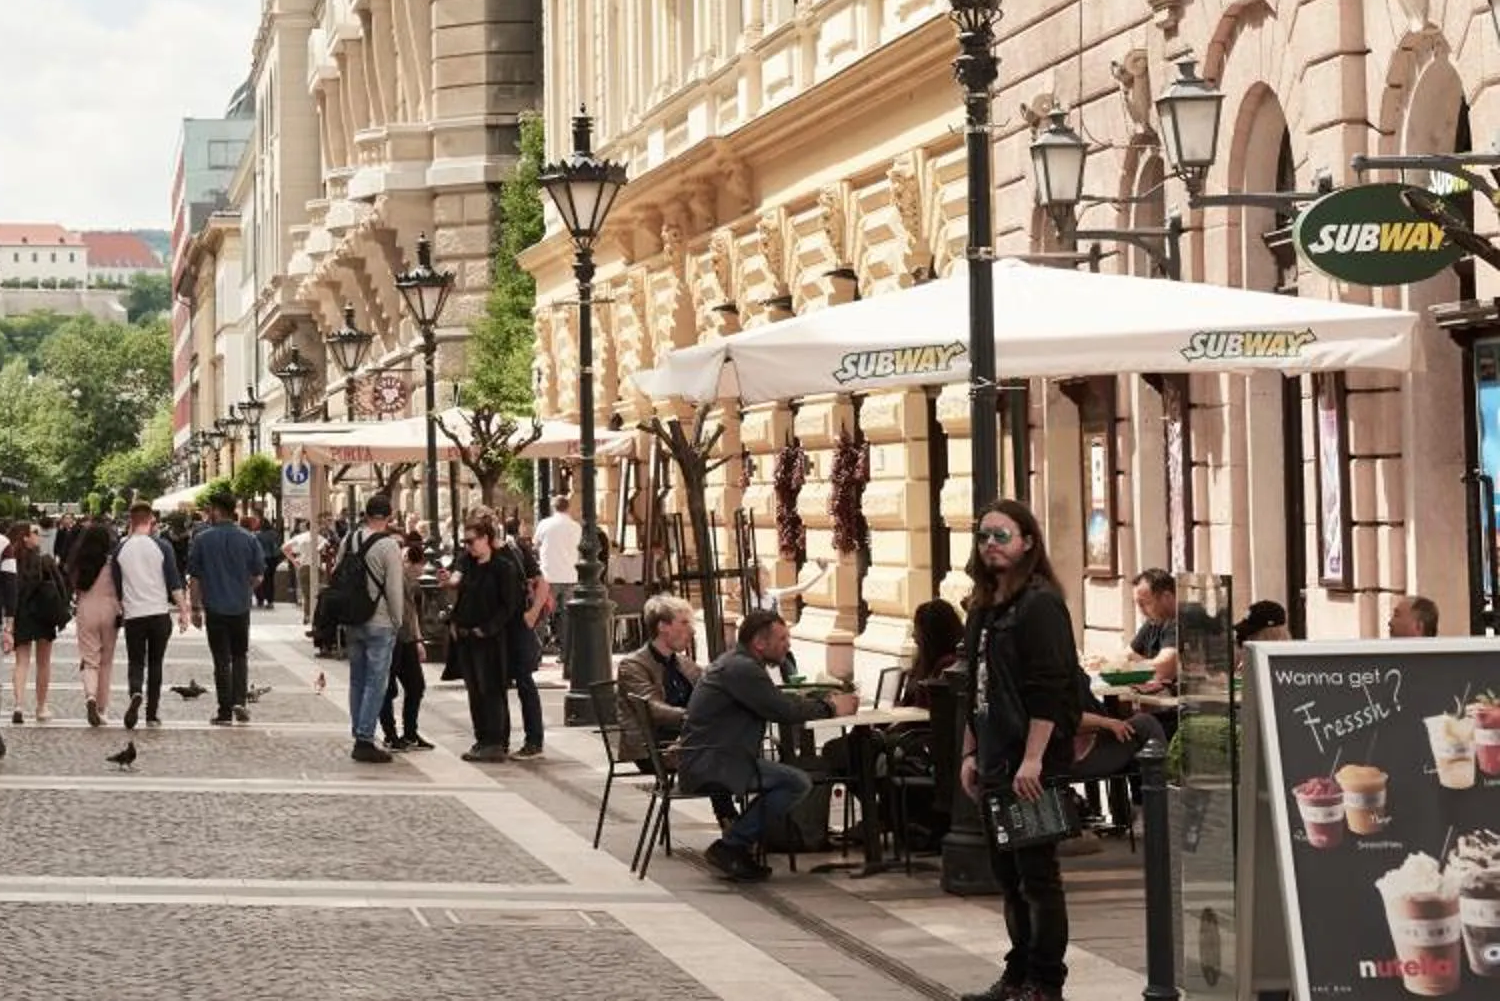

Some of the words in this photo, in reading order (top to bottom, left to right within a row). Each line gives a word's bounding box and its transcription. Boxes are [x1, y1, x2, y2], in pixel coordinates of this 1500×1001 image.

[1308, 221, 1446, 254] SUBWAY
[1180, 327, 1317, 362] SUBWAY
[833, 340, 967, 384] SUBWAY
[1275, 669, 1343, 687] Wanna
[1349, 668, 1381, 688] get
